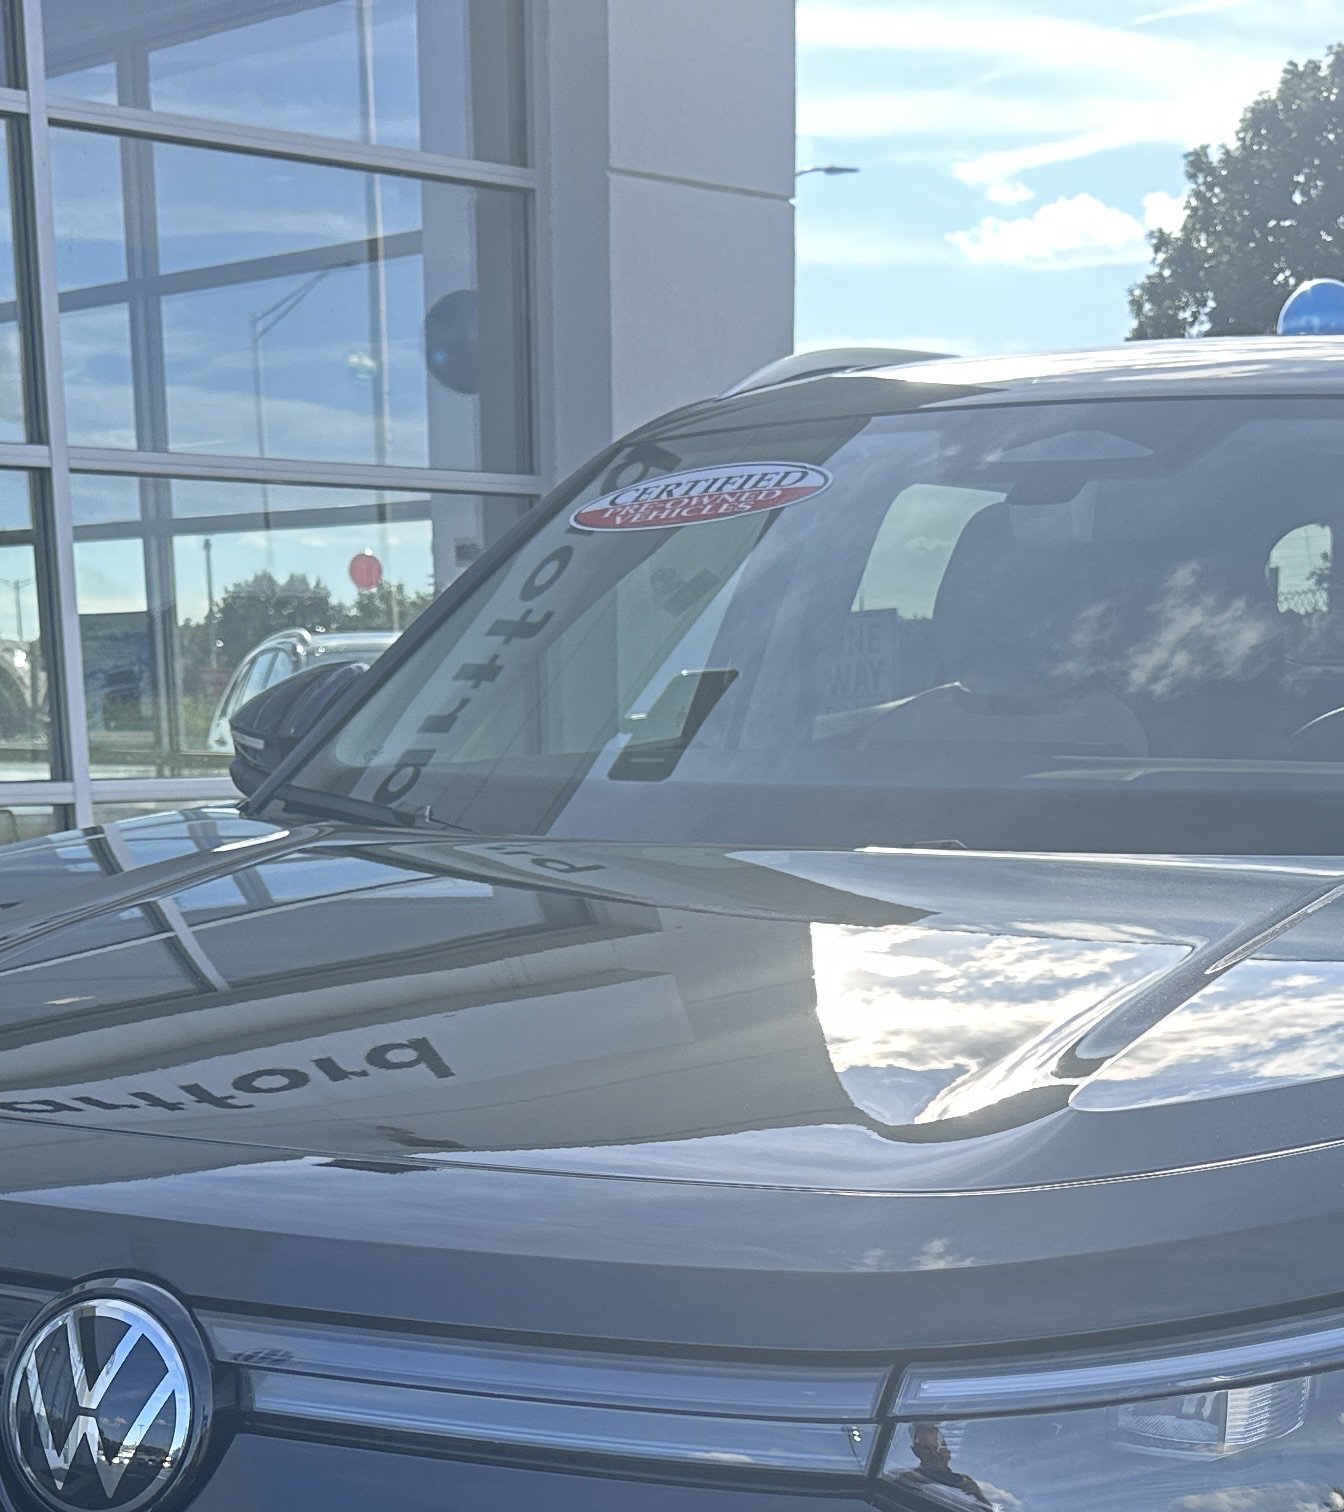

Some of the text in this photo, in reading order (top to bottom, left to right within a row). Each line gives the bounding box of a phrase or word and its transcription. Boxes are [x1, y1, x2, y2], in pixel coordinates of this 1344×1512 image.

[609, 470, 809, 507] CERTIFIED
[602, 490, 782, 519] PRE-OWNED
[615, 501, 756, 525] VEHICLES
